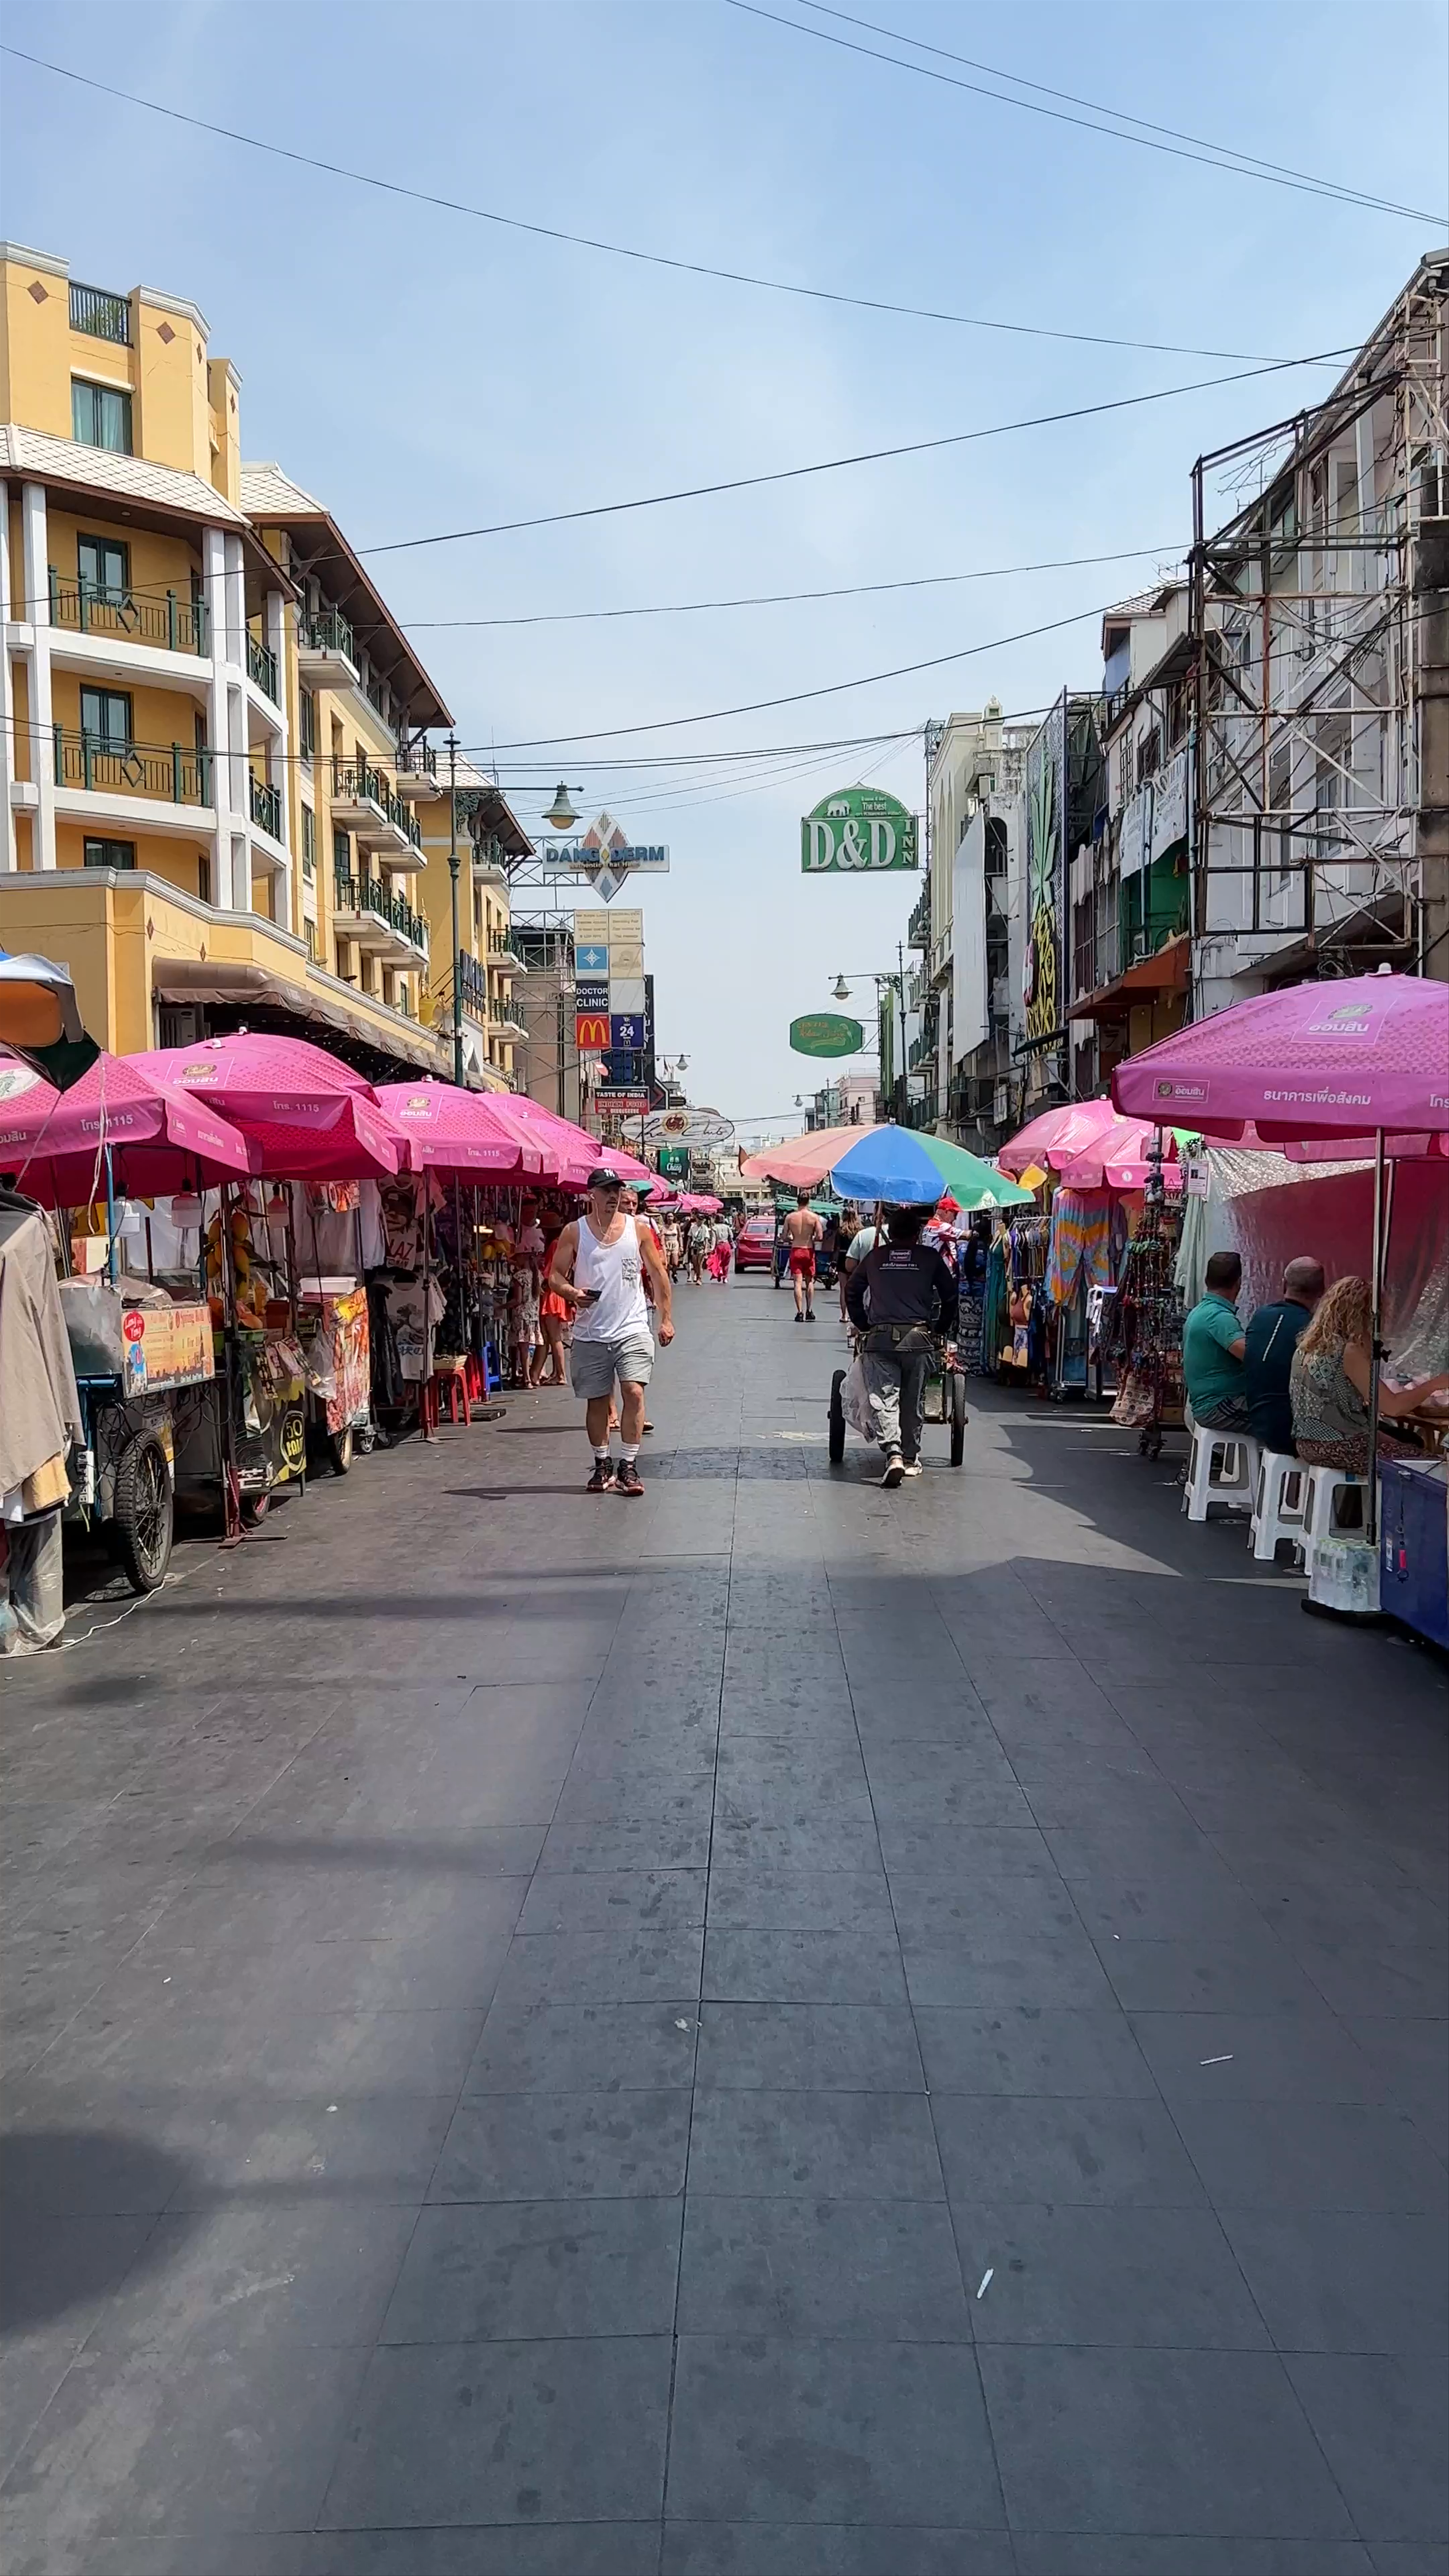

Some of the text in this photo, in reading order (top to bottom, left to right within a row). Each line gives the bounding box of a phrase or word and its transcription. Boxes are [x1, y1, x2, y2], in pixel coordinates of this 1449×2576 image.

[807, 820, 896, 869] D&D
[901, 819, 915, 864] INN
[546, 846, 664, 863] DANG DERM
[576, 998, 608, 1007] CLINIC
[619, 1026, 634, 1037] 24
[1263, 1086, 1372, 1105] ธนาคารเพื่อสังคม
[295, 1103, 320, 1112] 1115
[286, 1419, 302, 1439] 50
